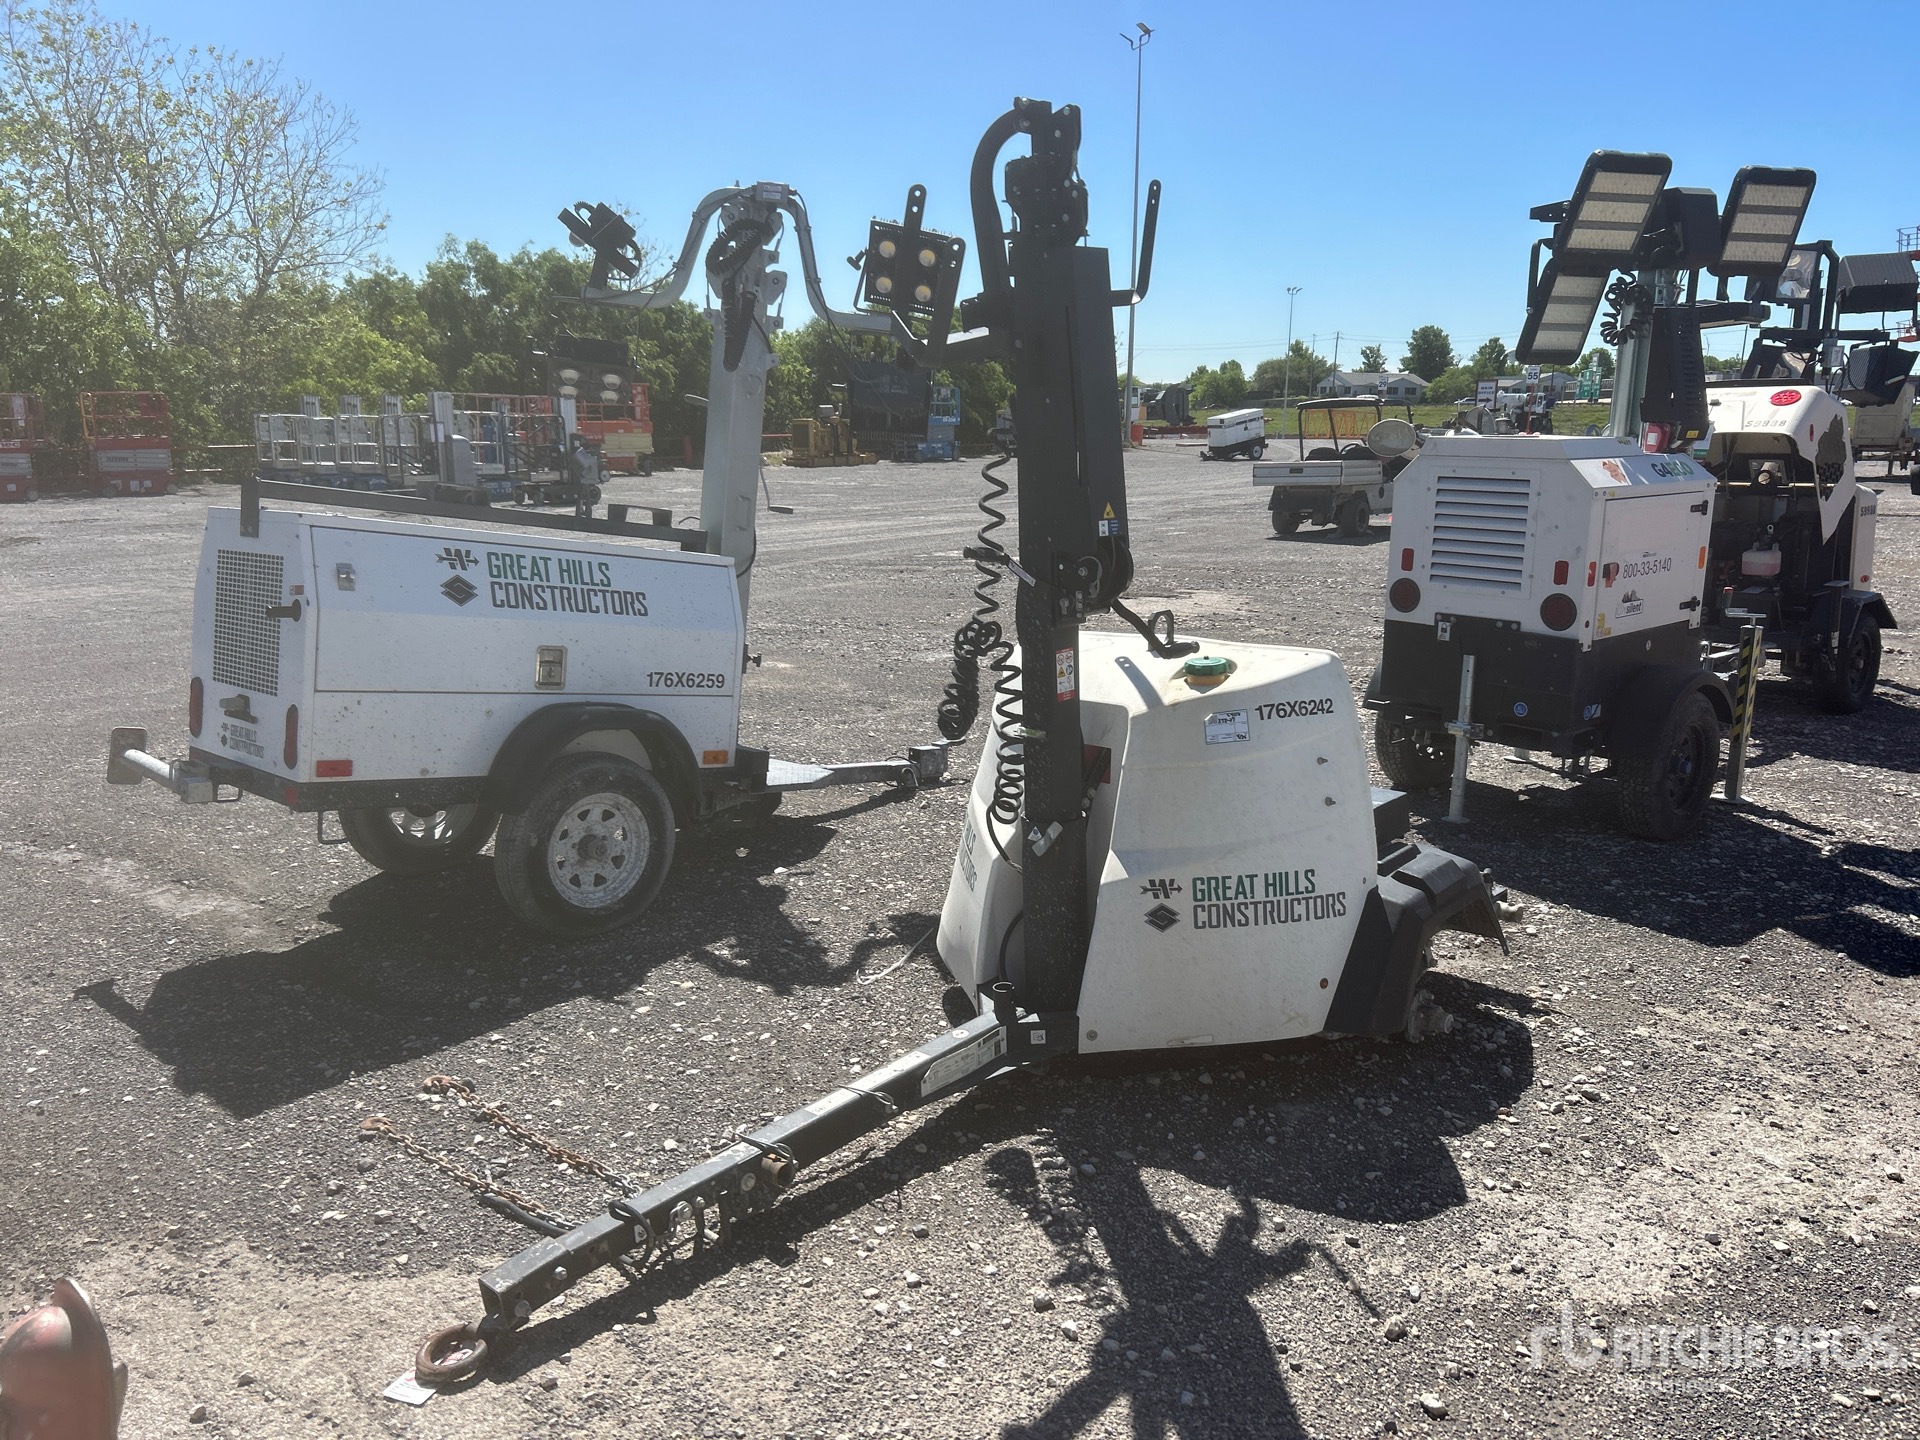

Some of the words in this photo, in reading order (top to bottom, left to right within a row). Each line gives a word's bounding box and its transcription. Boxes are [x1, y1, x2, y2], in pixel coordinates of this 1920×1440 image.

[1528, 371, 1539, 380] 55
[486, 551, 552, 583] GREAT
[557, 557, 612, 588] HILLS
[1623, 557, 1672, 579] 800-33-5140
[490, 580, 649, 617] CONSTRUCTORS
[1625, 601, 1642, 614] silent
[646, 671, 725, 689] 176X6259
[1254, 698, 1334, 721] 176X6242
[1192, 873, 1259, 903] GREAT
[1264, 868, 1316, 899] HILLS
[1193, 891, 1347, 930] CONSTRUCTORS
